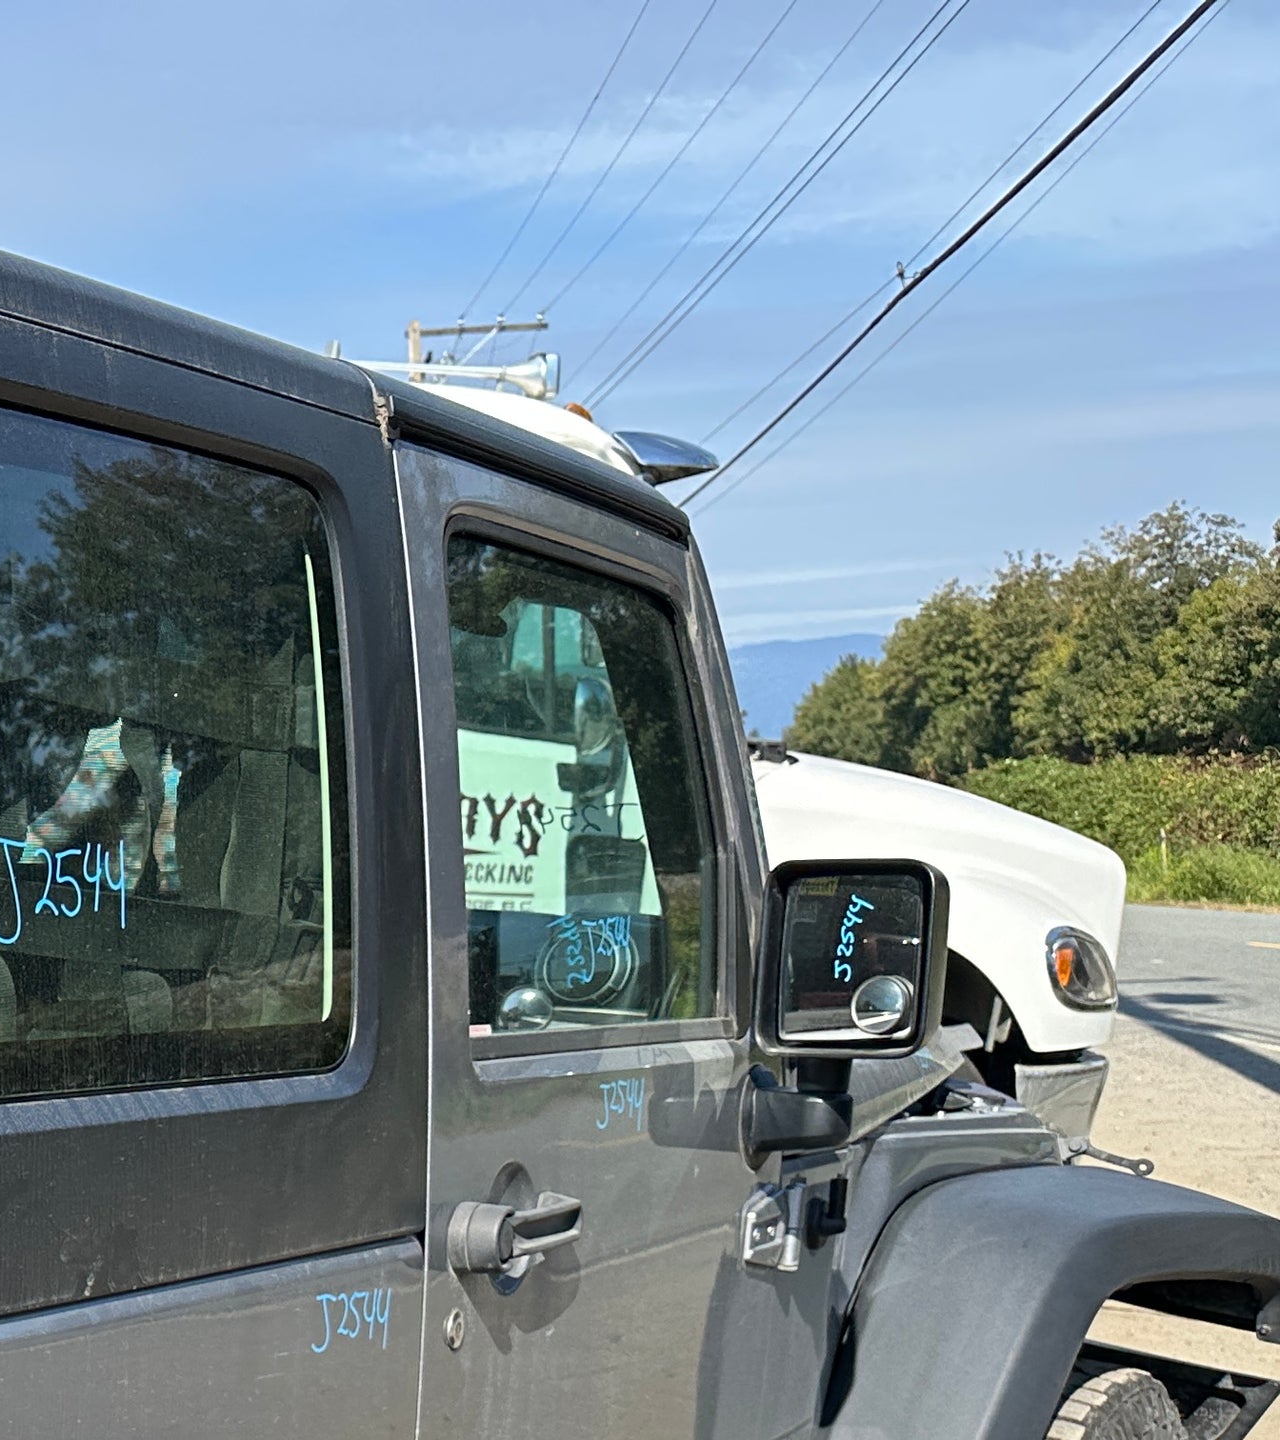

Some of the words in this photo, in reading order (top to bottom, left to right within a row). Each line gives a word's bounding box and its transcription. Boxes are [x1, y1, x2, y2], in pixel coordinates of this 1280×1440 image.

[833, 893, 875, 982] J2544
[596, 1076, 646, 1131] J2544
[311, 1287, 392, 1354] J2544
